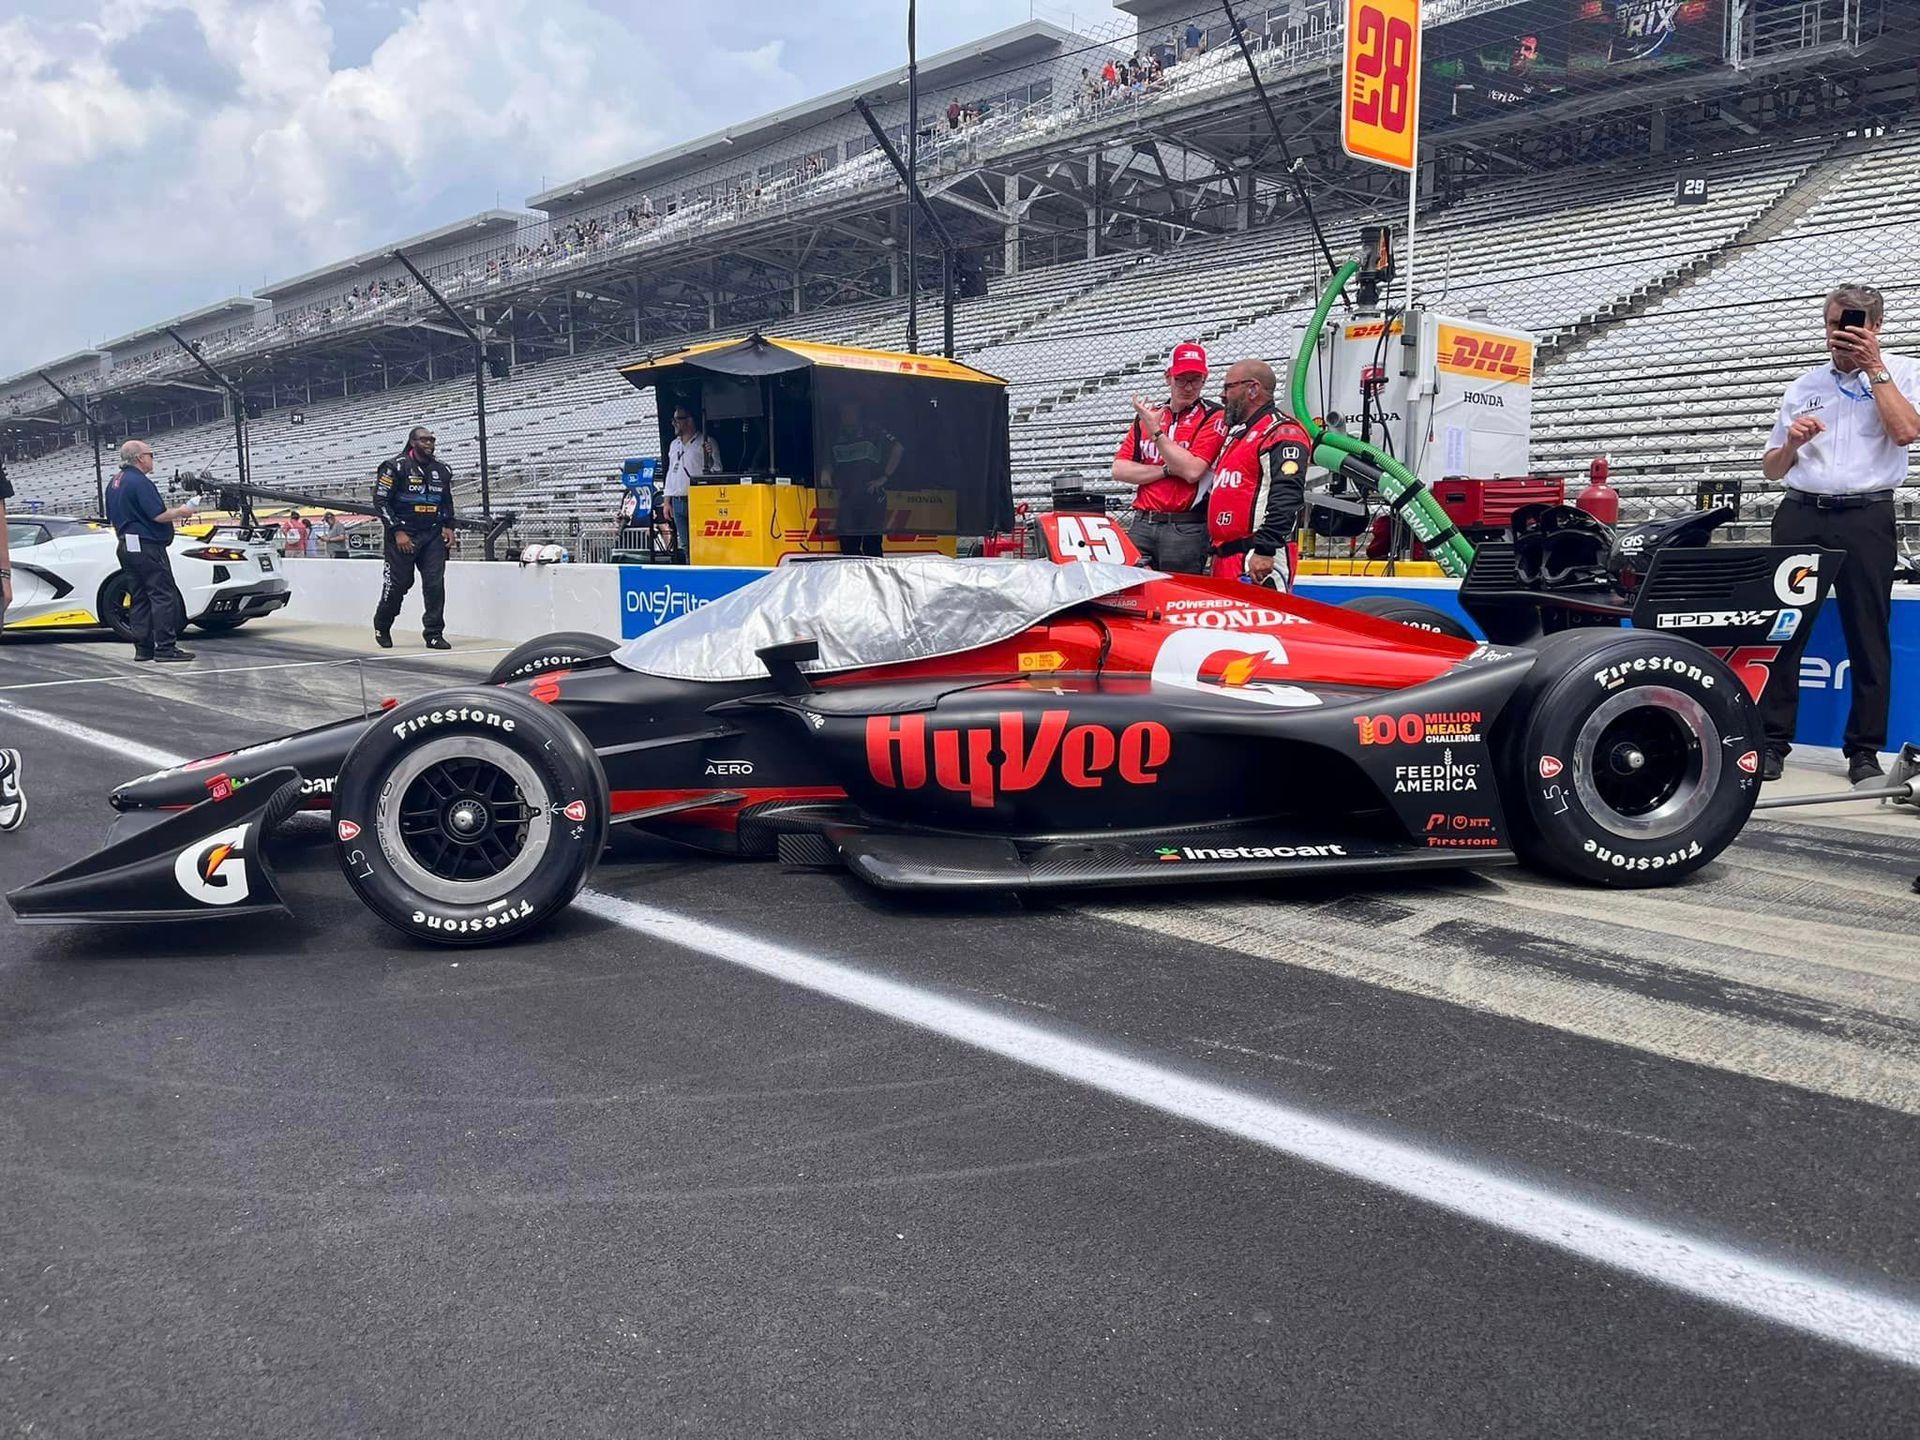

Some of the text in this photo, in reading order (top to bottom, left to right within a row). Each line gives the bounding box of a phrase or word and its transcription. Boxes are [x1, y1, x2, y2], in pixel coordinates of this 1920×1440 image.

[1352, 5, 1412, 134] 28
[1683, 179, 1706, 195] 29
[1451, 335, 1520, 375] DHL
[1463, 391, 1504, 407] HONDA
[704, 520, 745, 537] DHL
[1216, 511, 1233, 526] 45
[1057, 516, 1125, 565] 45
[1773, 553, 1822, 607] G
[627, 584, 711, 625] DNSFilte
[1166, 599, 1231, 611] POWERED
[1658, 613, 1715, 627] HPD
[1594, 656, 1715, 689] Firestone
[393, 706, 516, 740] Firestone
[1353, 712, 1481, 745] 100 MILLION
[1425, 723, 1472, 735] MEALS
[1425, 734, 1481, 743] CHALLENGE
[705, 759, 754, 775] AERO
[865, 709, 1171, 808] HyVee
[1395, 764, 1478, 779] FEEDING
[1394, 778, 1478, 793] AMERICA
[1427, 836, 1499, 847] Firestone
[174, 822, 252, 905] G
[1584, 839, 1703, 871] Firestone
[412, 899, 534, 932] Firestone
